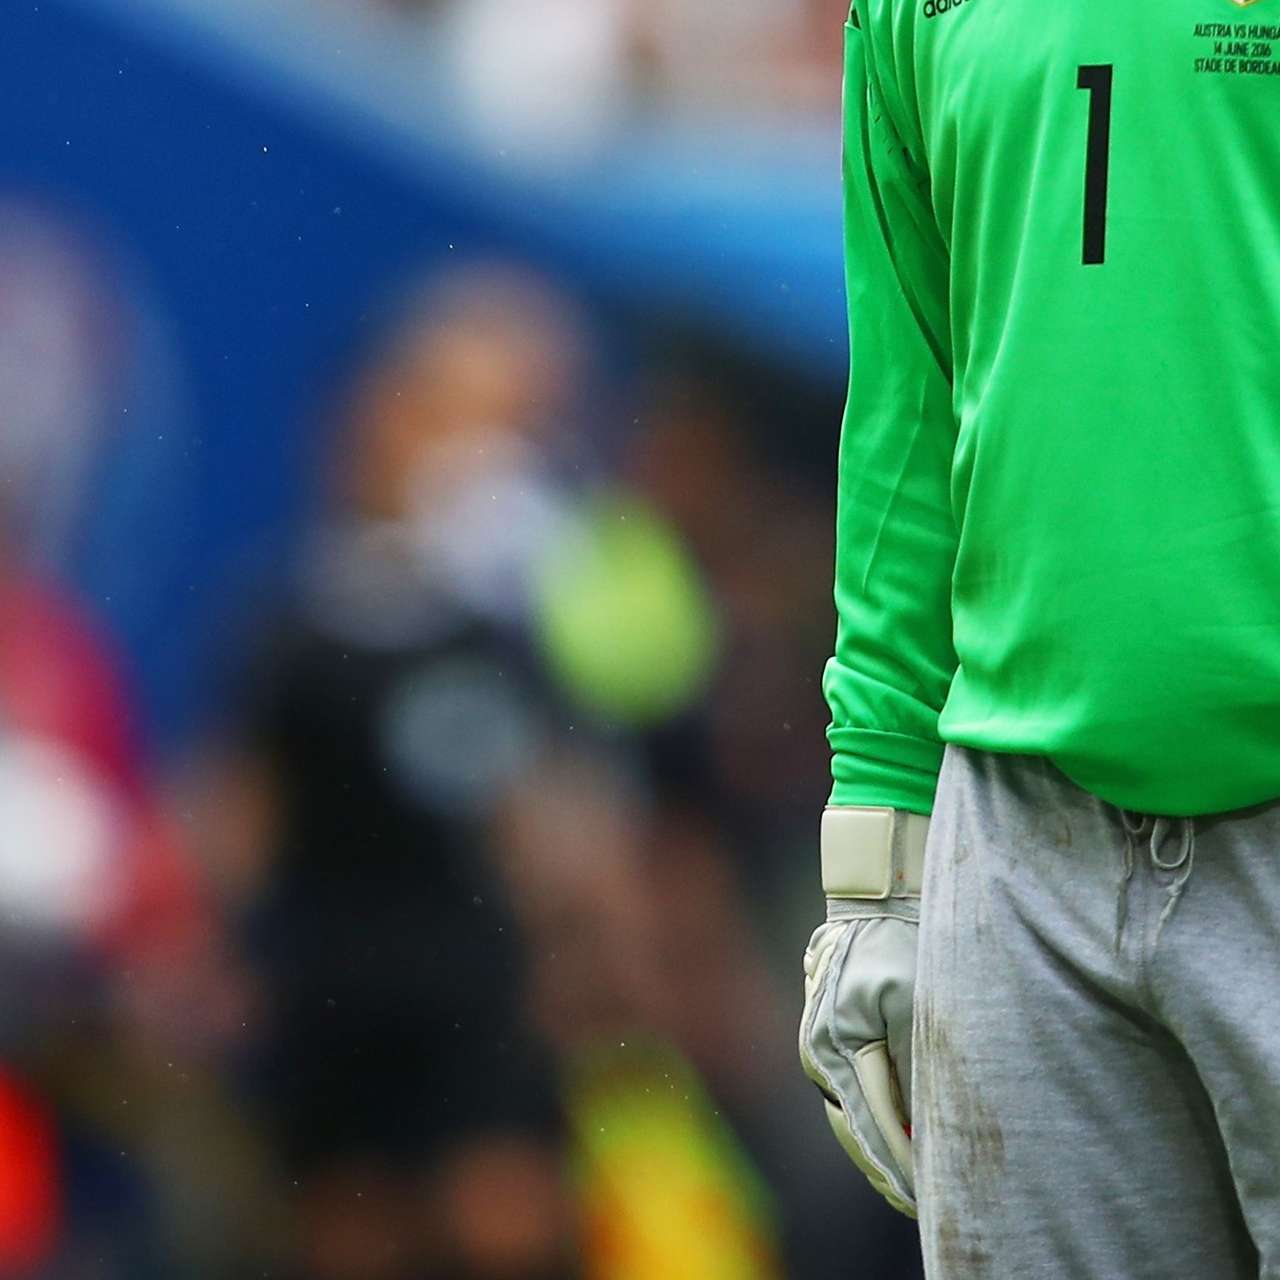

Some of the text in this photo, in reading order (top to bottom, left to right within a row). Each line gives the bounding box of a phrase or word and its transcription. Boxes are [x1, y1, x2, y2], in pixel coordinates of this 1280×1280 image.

[1193, 23, 1231, 37] AUSTRIA
[1234, 24, 1246, 38] VS
[1214, 41, 1272, 57] 14 JUNE 2016
[1194, 58, 1222, 72] STADE
[1224, 58, 1237, 73] DE
[1076, 64, 1113, 265] 1
